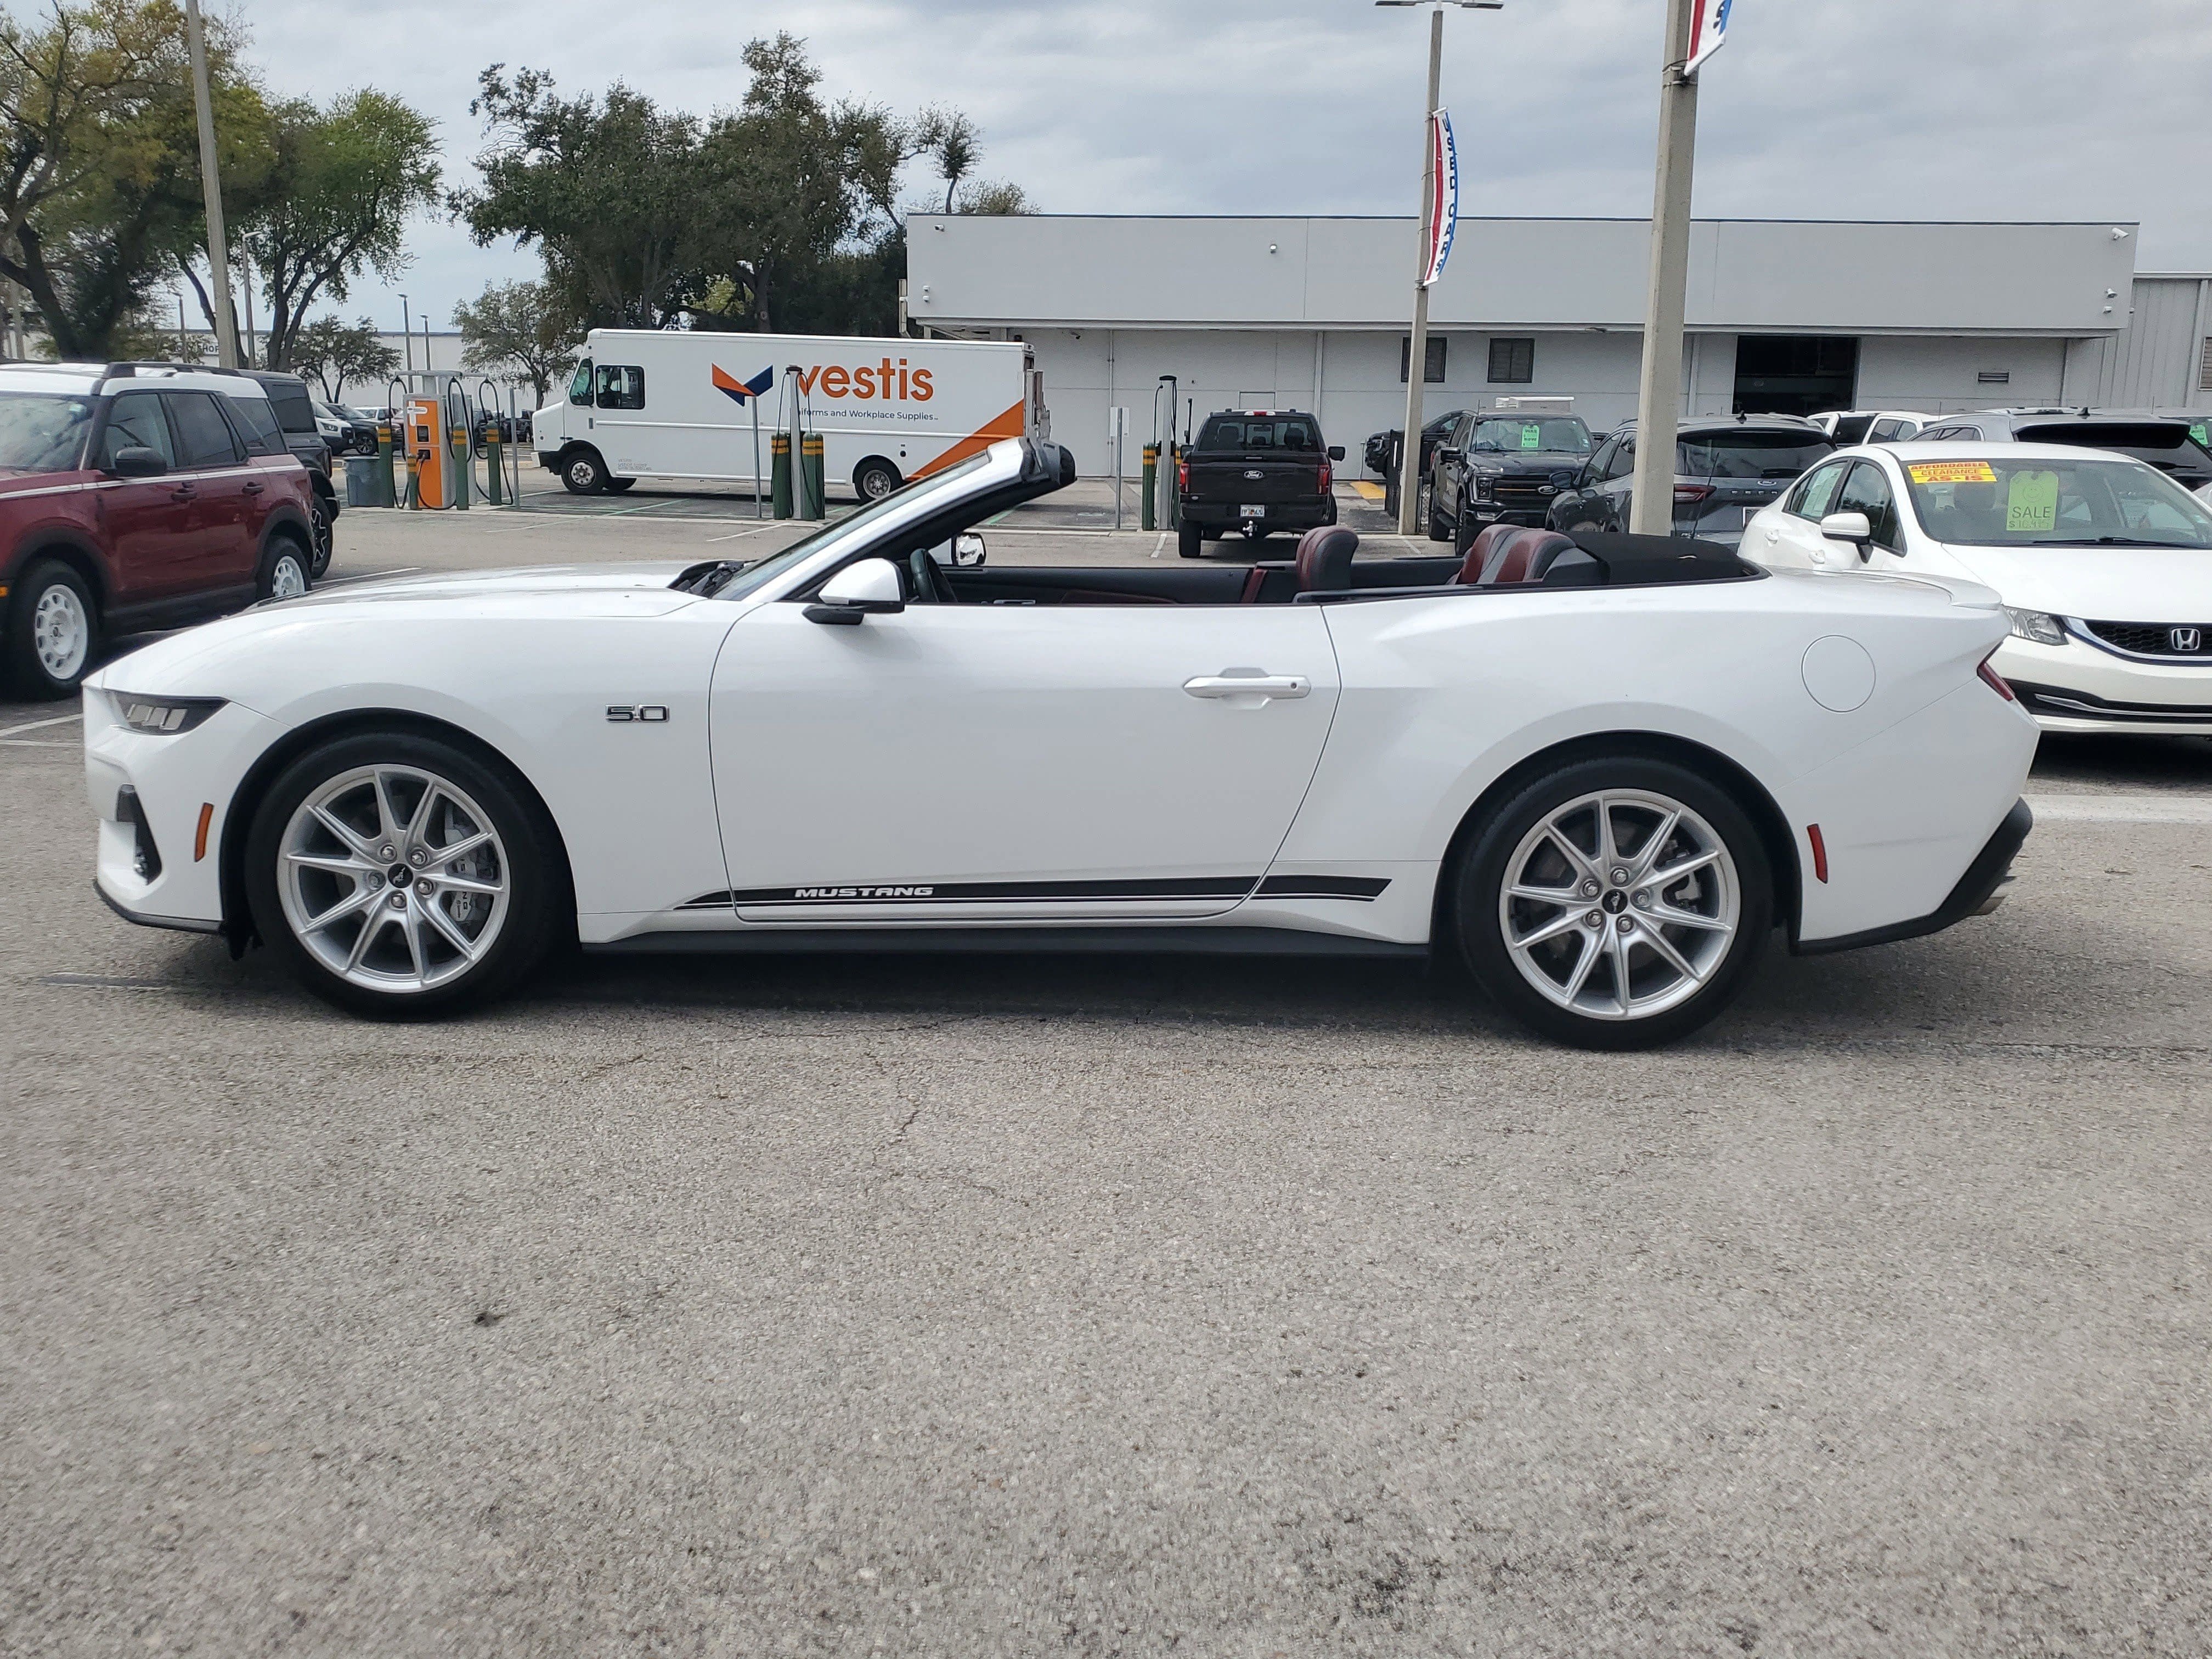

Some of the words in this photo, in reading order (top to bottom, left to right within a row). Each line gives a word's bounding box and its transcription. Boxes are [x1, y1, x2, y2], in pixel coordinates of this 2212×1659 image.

[1442, 118, 1455, 190] USED
[1435, 202, 1455, 272] CARS
[799, 358, 934, 401] vestis
[849, 410, 895, 420] Workplace
[896, 411, 933, 421] Supplies
[2012, 506, 2051, 518] SALE
[606, 705, 669, 723] 5.0
[794, 887, 934, 898] MUSTANG
